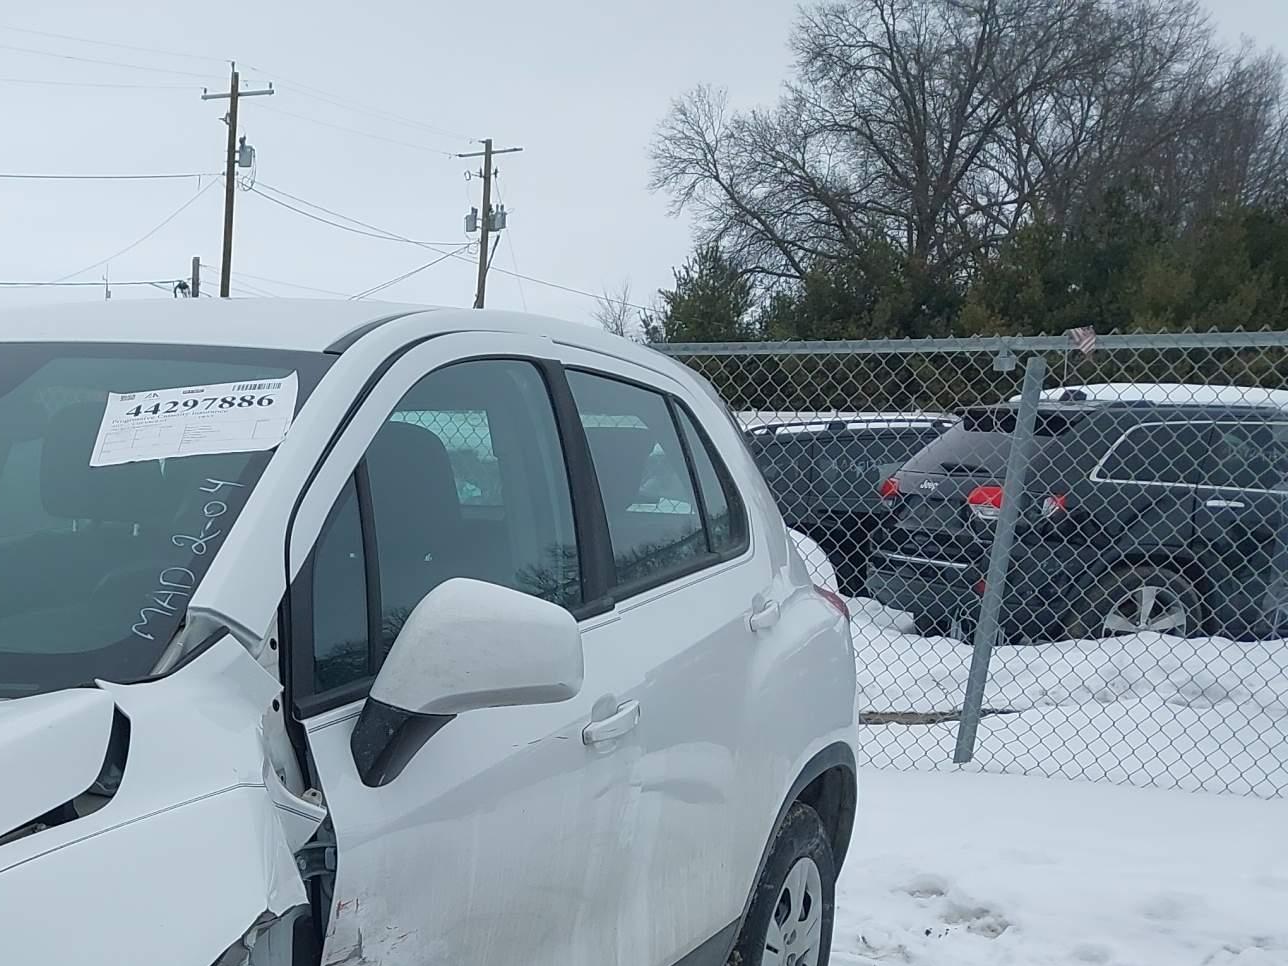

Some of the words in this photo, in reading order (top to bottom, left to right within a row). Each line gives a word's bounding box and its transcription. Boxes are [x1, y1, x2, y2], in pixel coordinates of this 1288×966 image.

[125, 394, 278, 417] 44297886
[112, 415, 155, 426] Progressive
[920, 479, 939, 491] Jeep
